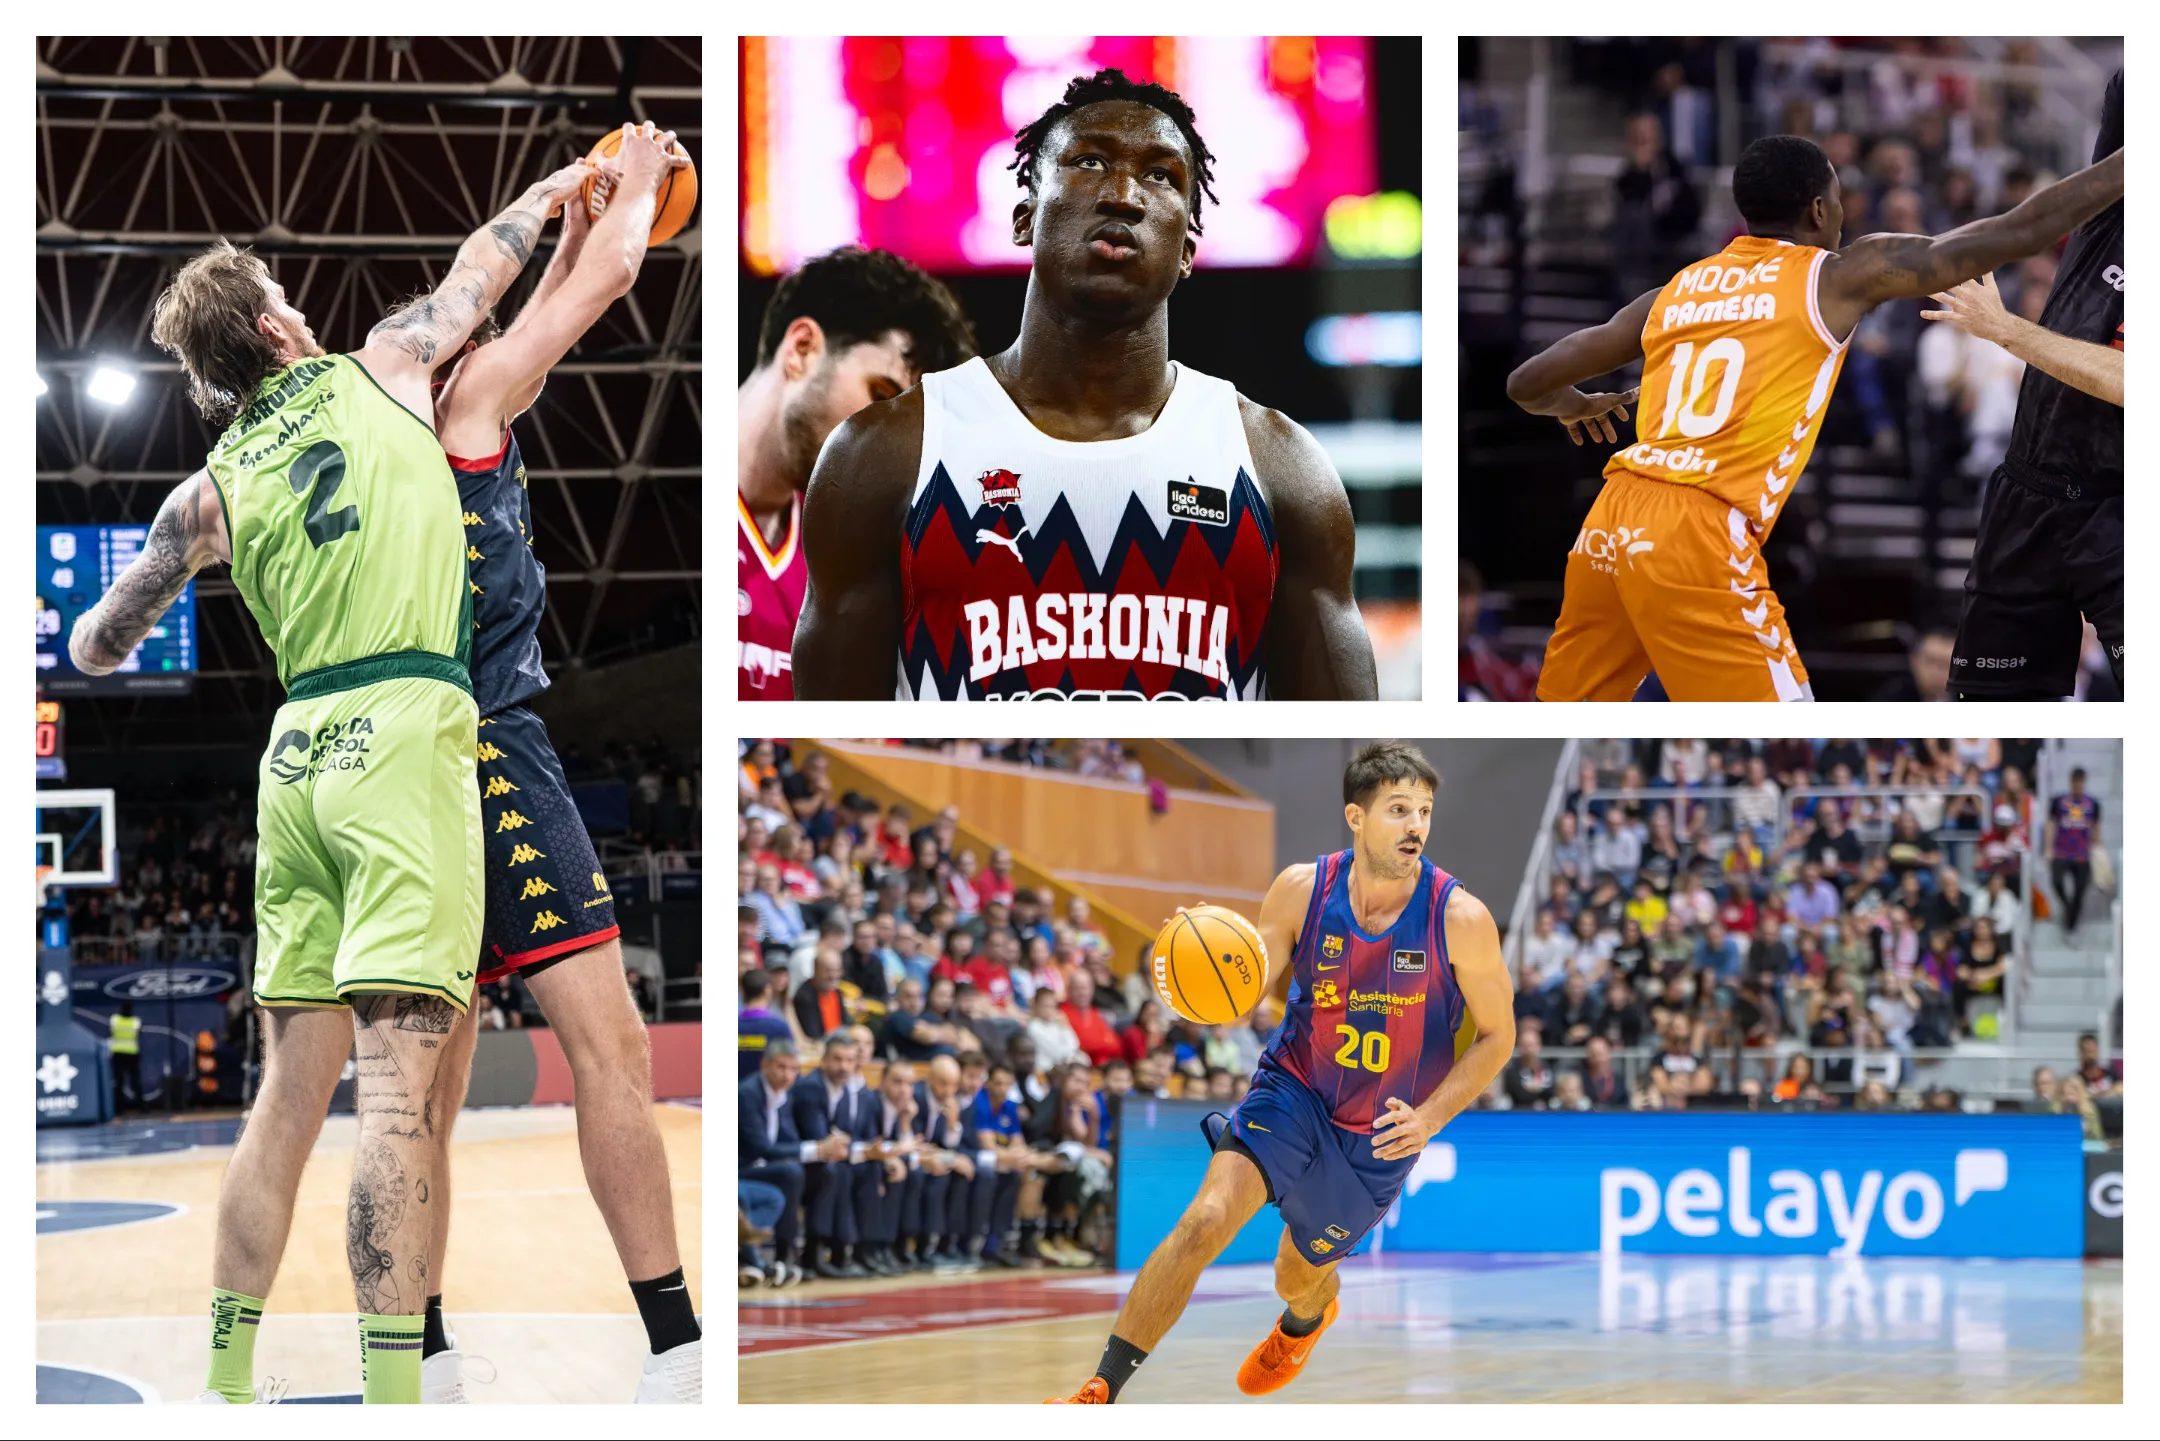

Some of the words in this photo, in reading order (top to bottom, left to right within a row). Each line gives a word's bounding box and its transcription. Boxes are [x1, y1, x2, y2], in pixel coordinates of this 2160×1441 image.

[1673, 256, 1784, 298] MOORE
[1663, 292, 1777, 331] PAMESA
[1657, 338, 1745, 439] 10
[288, 439, 361, 551] 2
[983, 487, 1020, 501] BASKONIA
[1172, 490, 1197, 505] liga
[1172, 503, 1225, 520] endesa
[964, 592, 1230, 688] BASKONIA
[333, 738, 370, 753] SOL
[1234, 955, 1252, 985] acb
[1397, 956, 1410, 965] liga
[1397, 962, 1424, 970] endesa
[128, 972, 210, 997] Ford
[1348, 989, 1426, 1006] Assistència
[1349, 1001, 1404, 1018] Sanitària
[420, 1039, 438, 1049] VENI
[1335, 1024, 1391, 1073] 20
[1601, 1146, 1944, 1258] pelayo
[211, 1304, 237, 1351] UNICAJA
